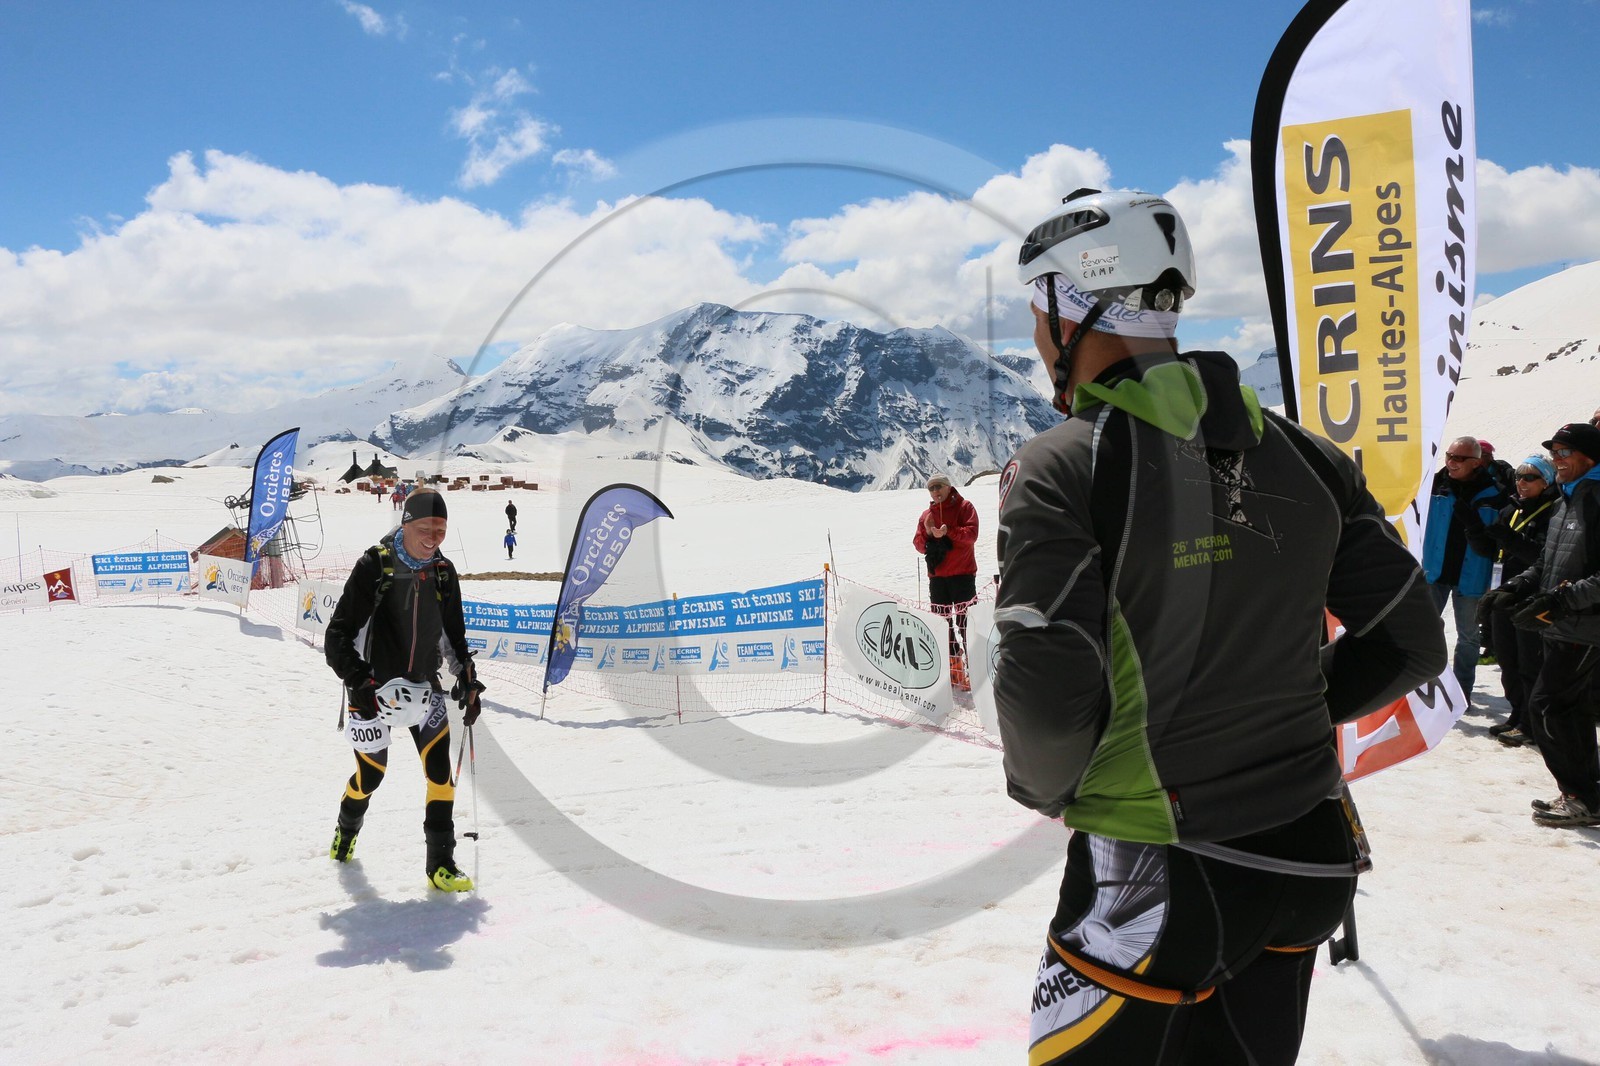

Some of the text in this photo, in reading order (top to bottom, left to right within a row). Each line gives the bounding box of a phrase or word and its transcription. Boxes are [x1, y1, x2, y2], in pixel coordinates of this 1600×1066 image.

[1083, 266, 1114, 279] CAMP
[1369, 181, 1412, 444] Hautes-Alpes
[260, 451, 283, 518] Orcières
[281, 465, 293, 503] 1850
[571, 502, 627, 586] Orcières
[598, 526, 631, 577] 1850
[1195, 534, 1230, 551] PIERRA
[97, 564, 143, 572] ALPINISME
[114, 555, 143, 563] ÉCRINS
[161, 554, 187, 562] ÉCRINS
[1174, 548, 1233, 569] MENTA 2011
[4, 581, 41, 594] Alpes
[462, 605, 472, 614] KI
[476, 604, 508, 617] ÉCRINS
[514, 609, 529, 617] SKI
[584, 609, 619, 621] ÉCRINS
[623, 610, 637, 620] SKI
[638, 607, 664, 619] ÉCRINS
[682, 600, 724, 615] ÉCRINS
[731, 597, 751, 609] SKI
[751, 592, 792, 607] ÉCRINS
[798, 588, 815, 602] SKI
[464, 617, 509, 628] LPINISME
[578, 624, 619, 634] PINISME
[626, 622, 665, 634] ALPINISME
[736, 609, 793, 626] ALPINISME
[737, 645, 754, 656] TEAM
[351, 726, 382, 743] 300b
